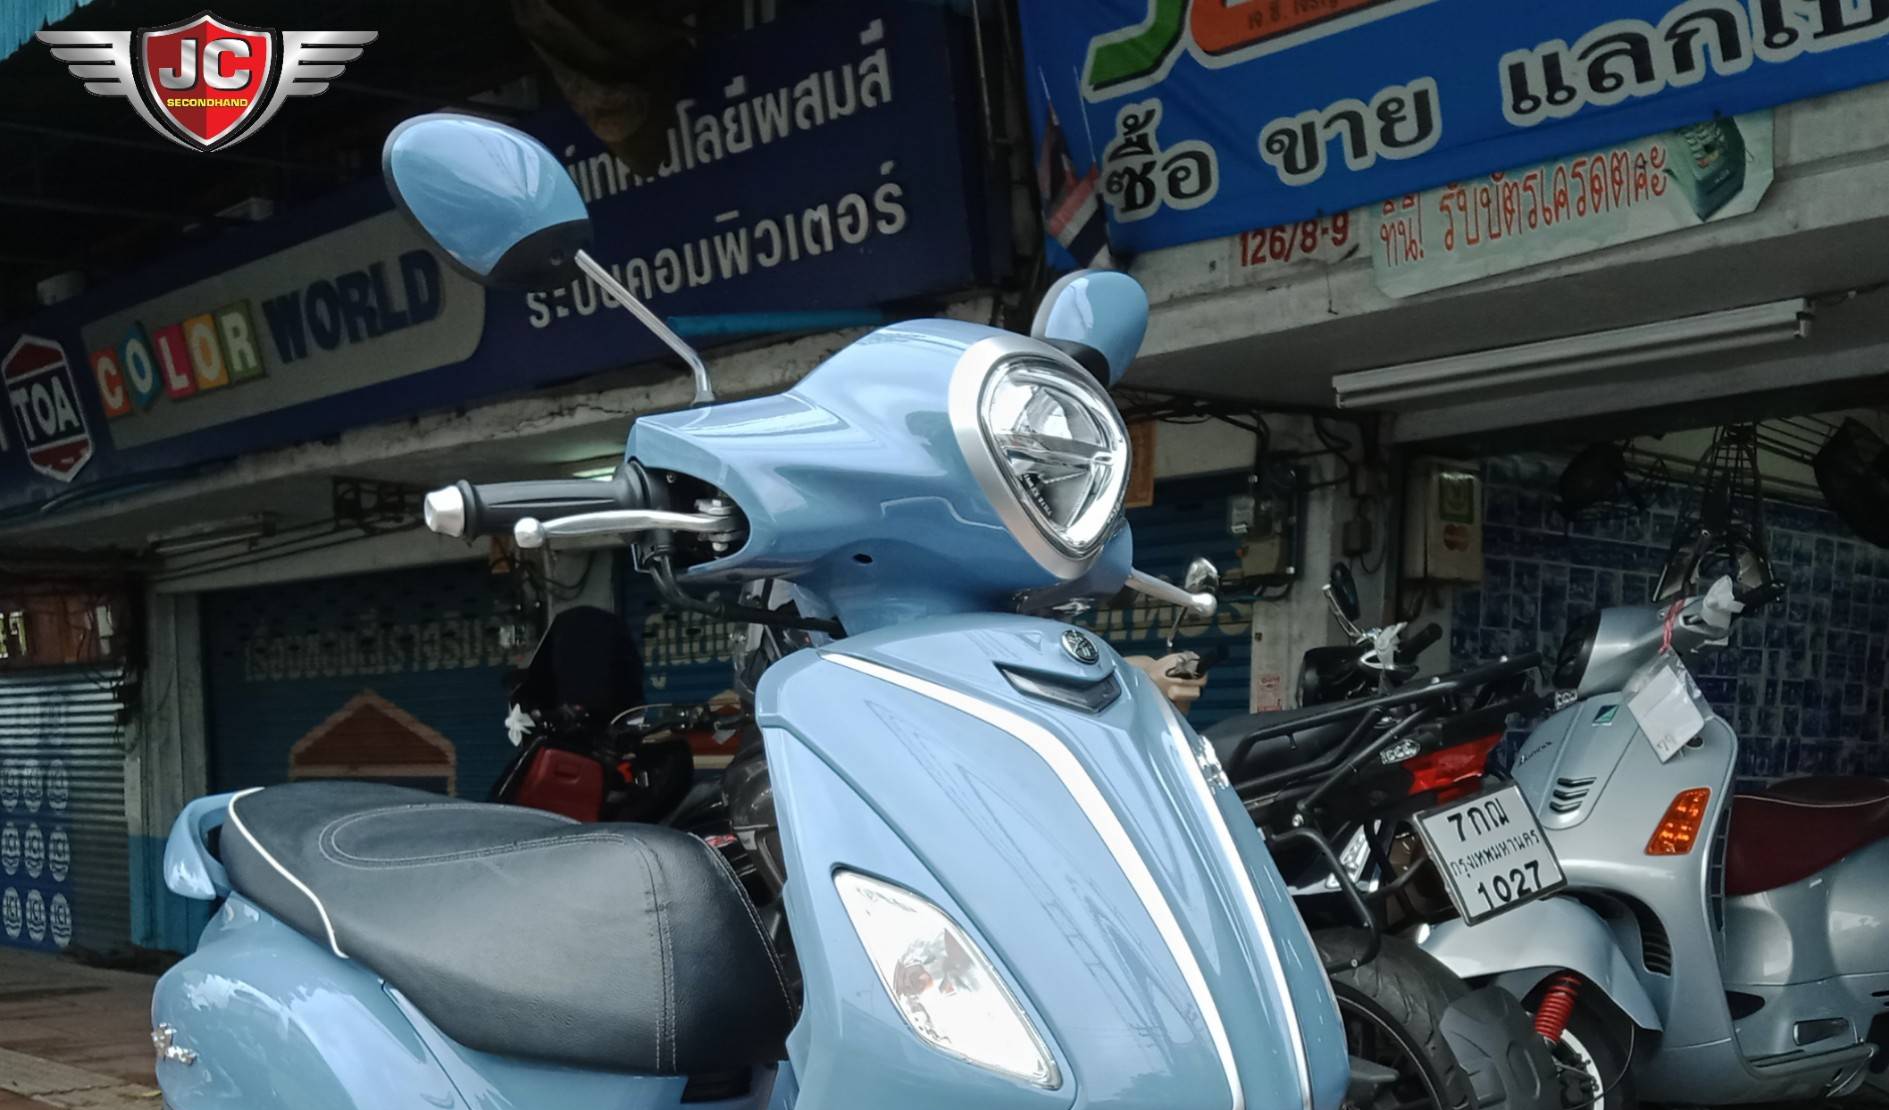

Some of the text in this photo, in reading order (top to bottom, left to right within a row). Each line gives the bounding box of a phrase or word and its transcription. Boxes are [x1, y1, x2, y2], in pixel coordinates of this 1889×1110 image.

[1105, 108, 1213, 214] ซื้อ
[1264, 88, 1435, 176] ขาย
[1239, 210, 1351, 268] 126/8-9
[97, 249, 443, 411] COLOR WORLD
[10, 374, 81, 442] TOA
[1450, 829, 1541, 878] กรุงเทพมหานคร
[1477, 859, 1543, 911] 1027
